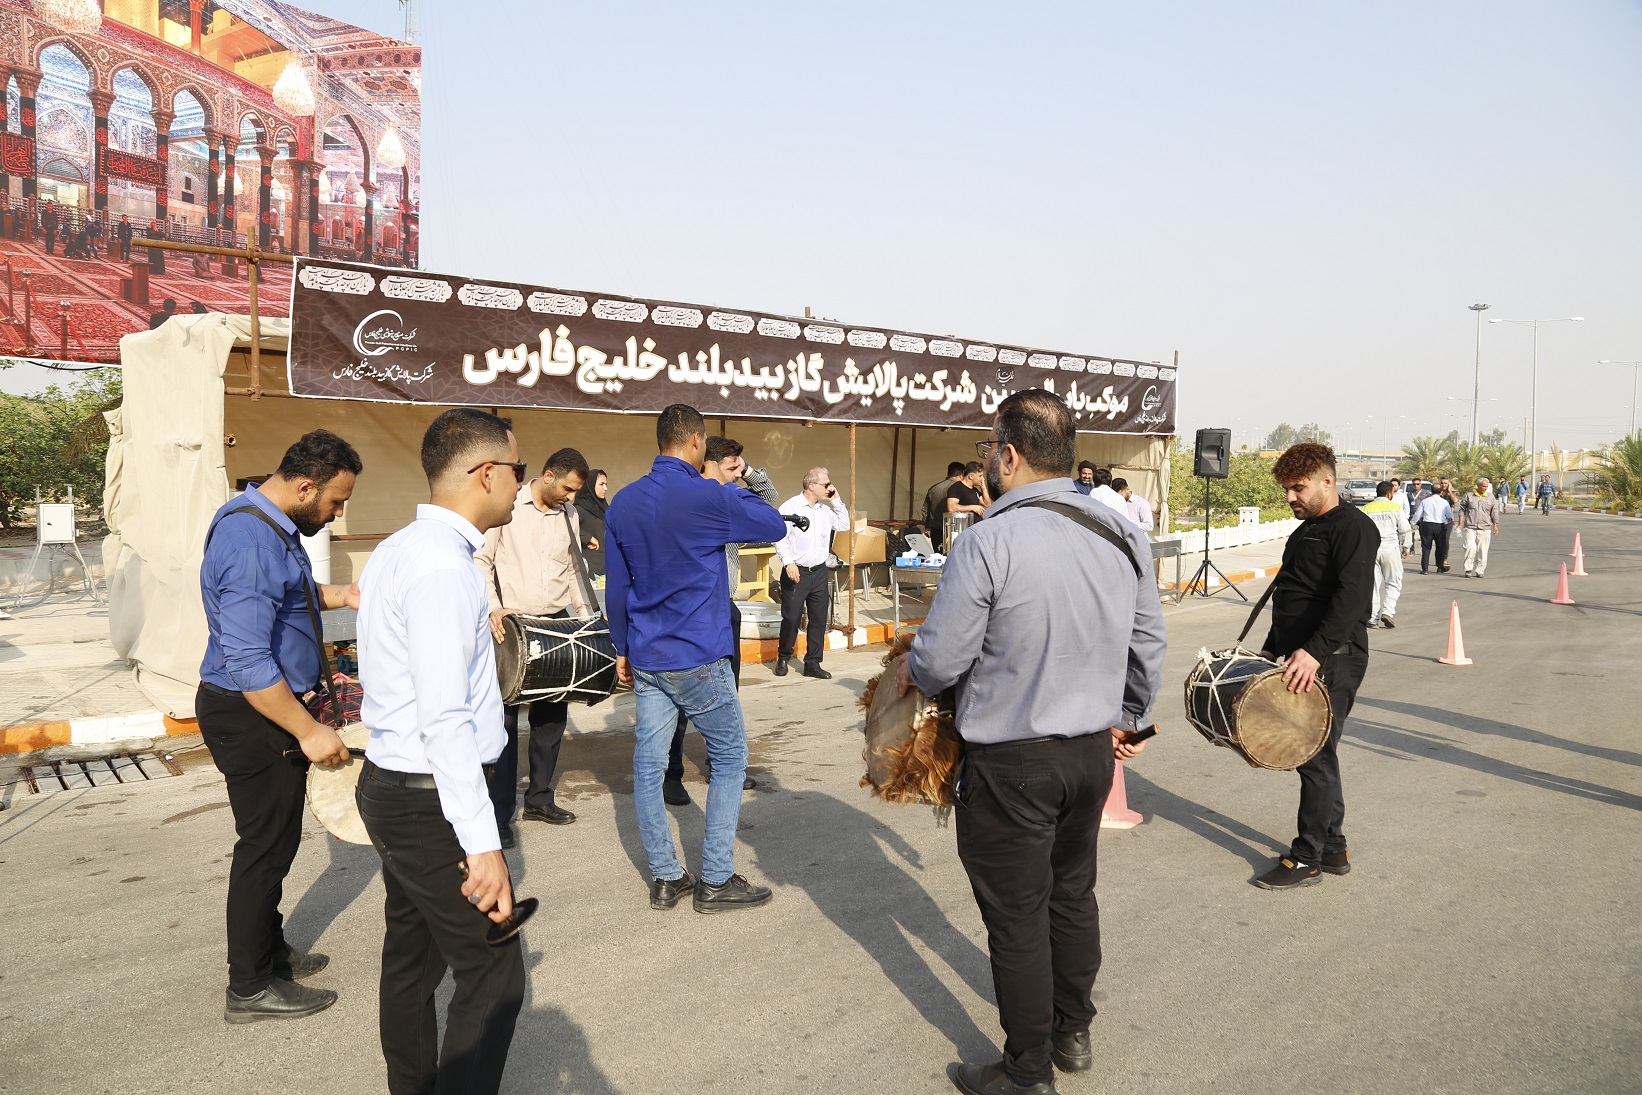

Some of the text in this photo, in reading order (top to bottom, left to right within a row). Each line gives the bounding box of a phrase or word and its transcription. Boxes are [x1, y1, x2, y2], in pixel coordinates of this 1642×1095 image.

[333, 363, 353, 379] فارس
[352, 357, 368, 381] خلیج
[391, 364, 411, 385] پالایش
[409, 361, 436, 384] شرکت
[462, 323, 576, 388] فارس
[576, 335, 668, 394] خلیج
[783, 351, 825, 401] گاز
[823, 357, 909, 416] پالایش
[908, 369, 977, 411] شرکت
[1085, 385, 1130, 420] موکب
